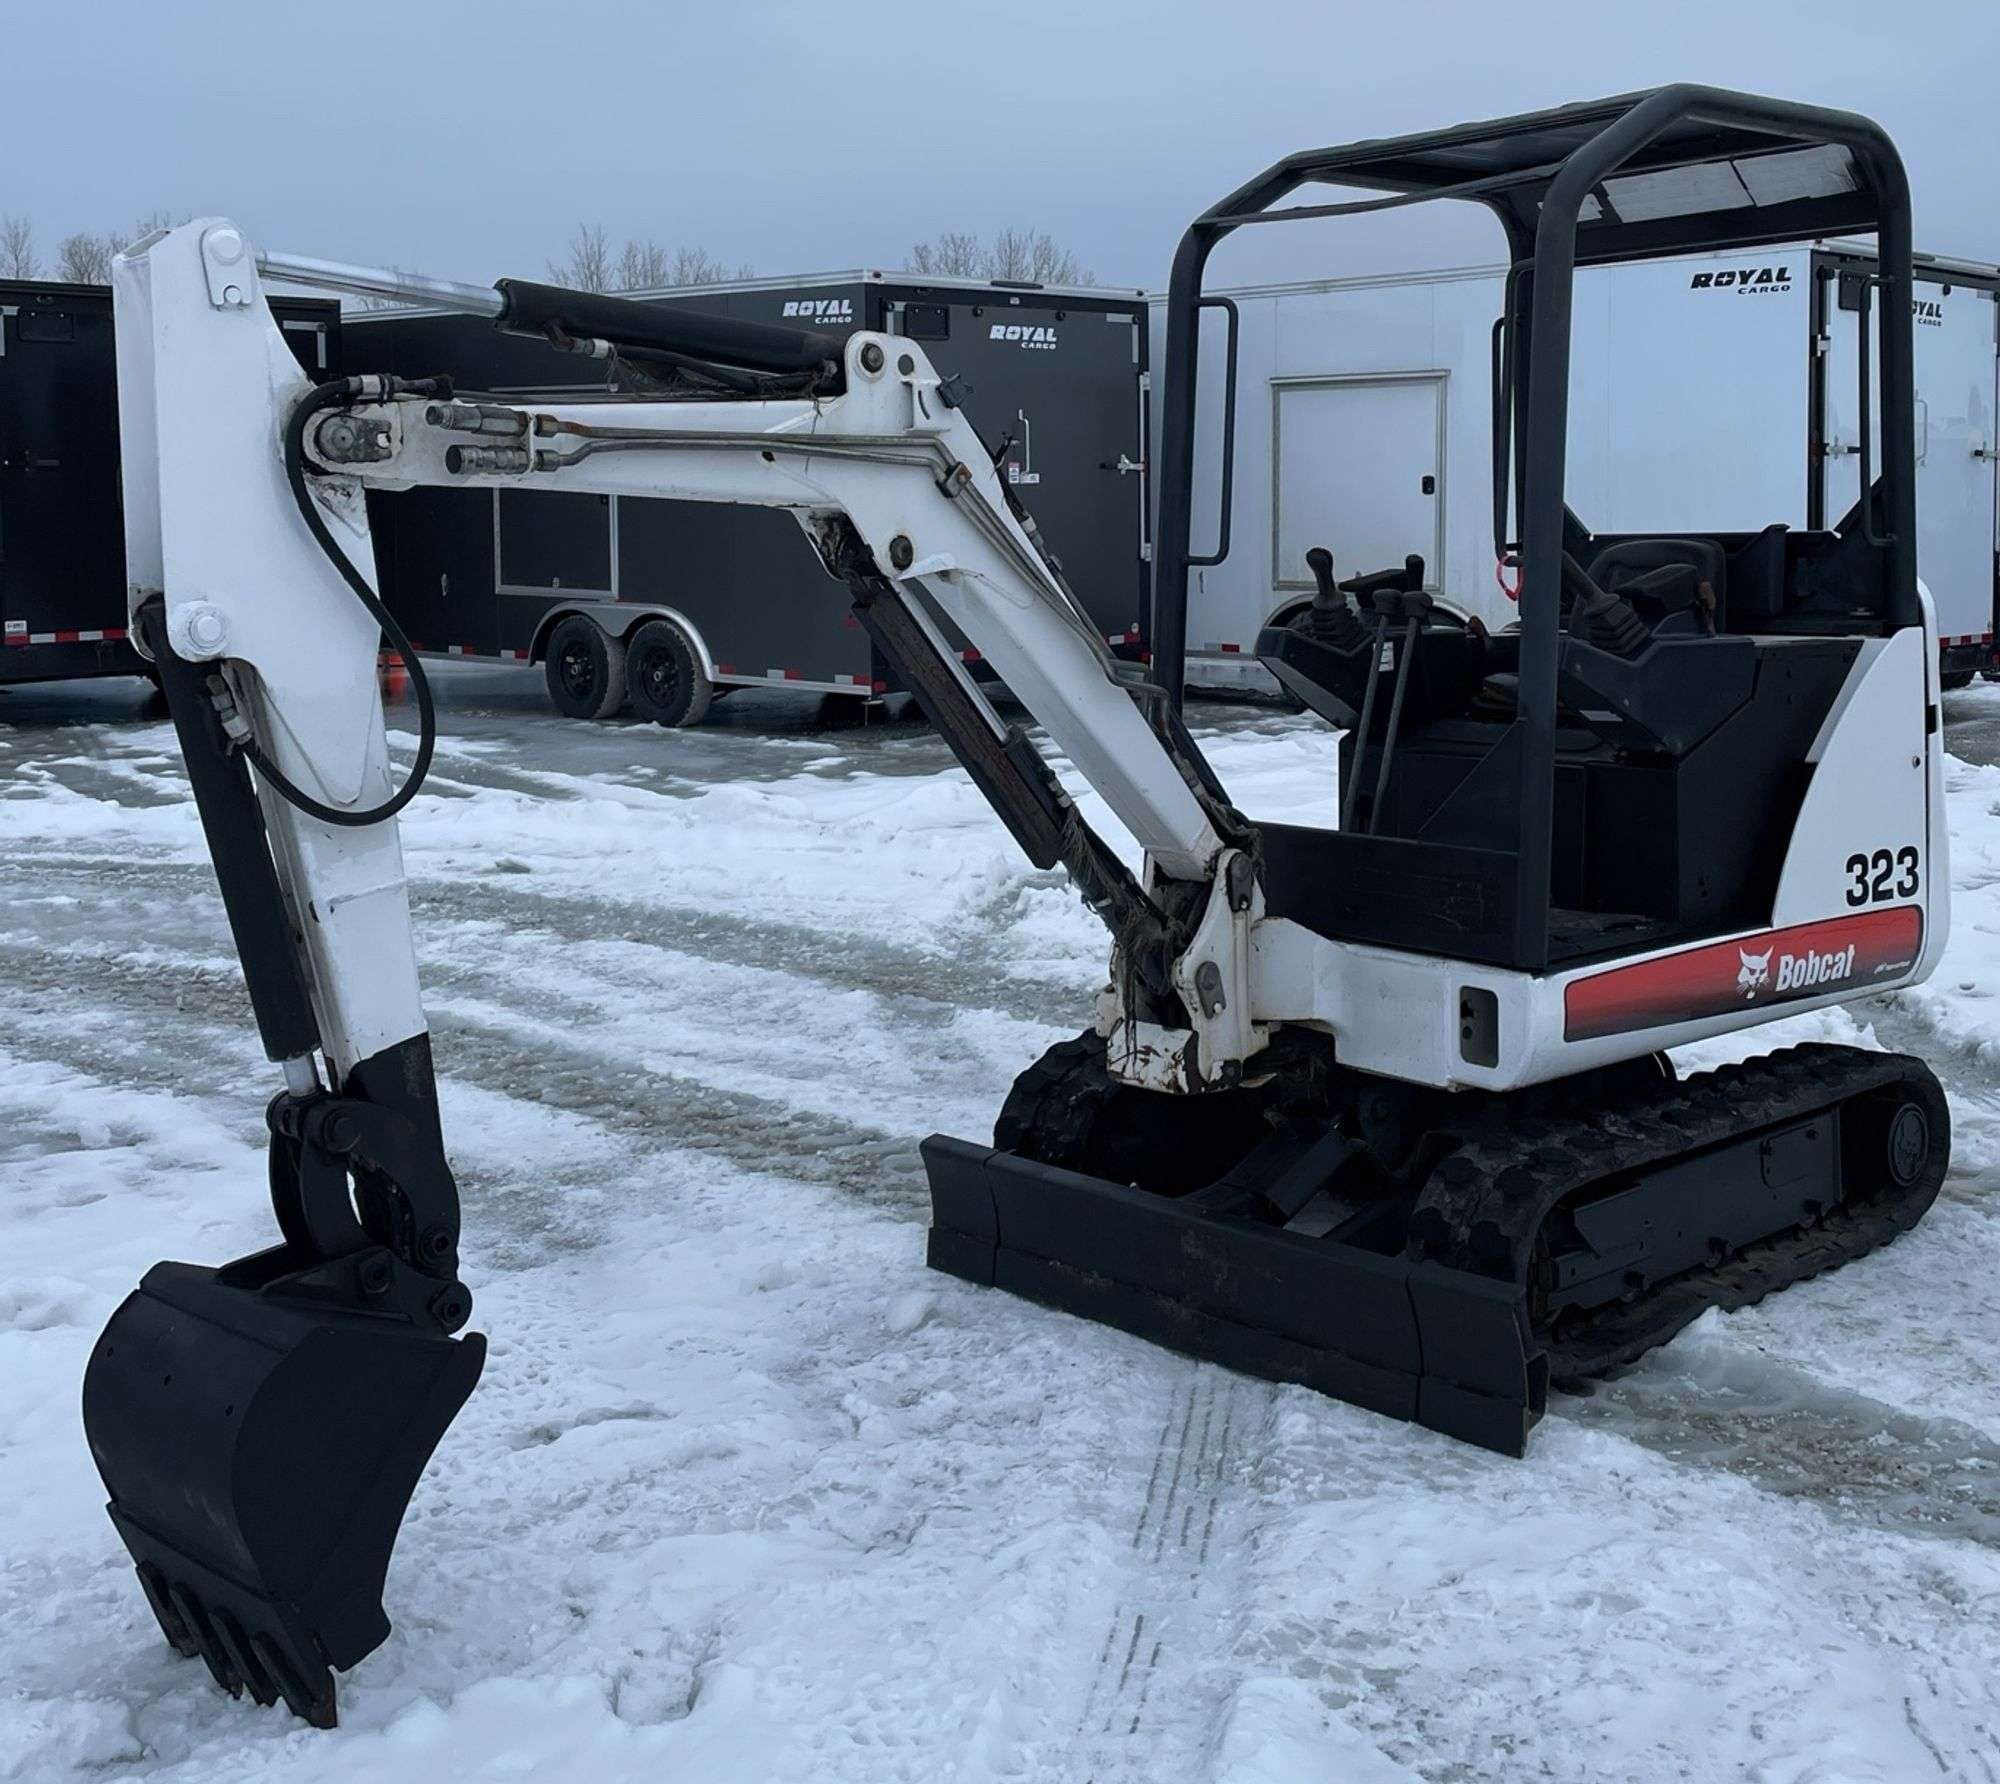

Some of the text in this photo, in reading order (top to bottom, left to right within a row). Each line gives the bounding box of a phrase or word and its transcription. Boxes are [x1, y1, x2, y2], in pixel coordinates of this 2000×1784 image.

[1690, 267, 1792, 289] ROYAL
[1737, 285, 1791, 295] CARGO
[782, 299, 853, 317] ROYAL
[1912, 300, 1942, 318] YAL
[814, 316, 852, 324] CARGO
[989, 325, 1057, 342] ROYAL
[1021, 341, 1057, 350] CARGO
[1847, 846, 1919, 906] 323
[1776, 944, 1854, 991] Bobcat
